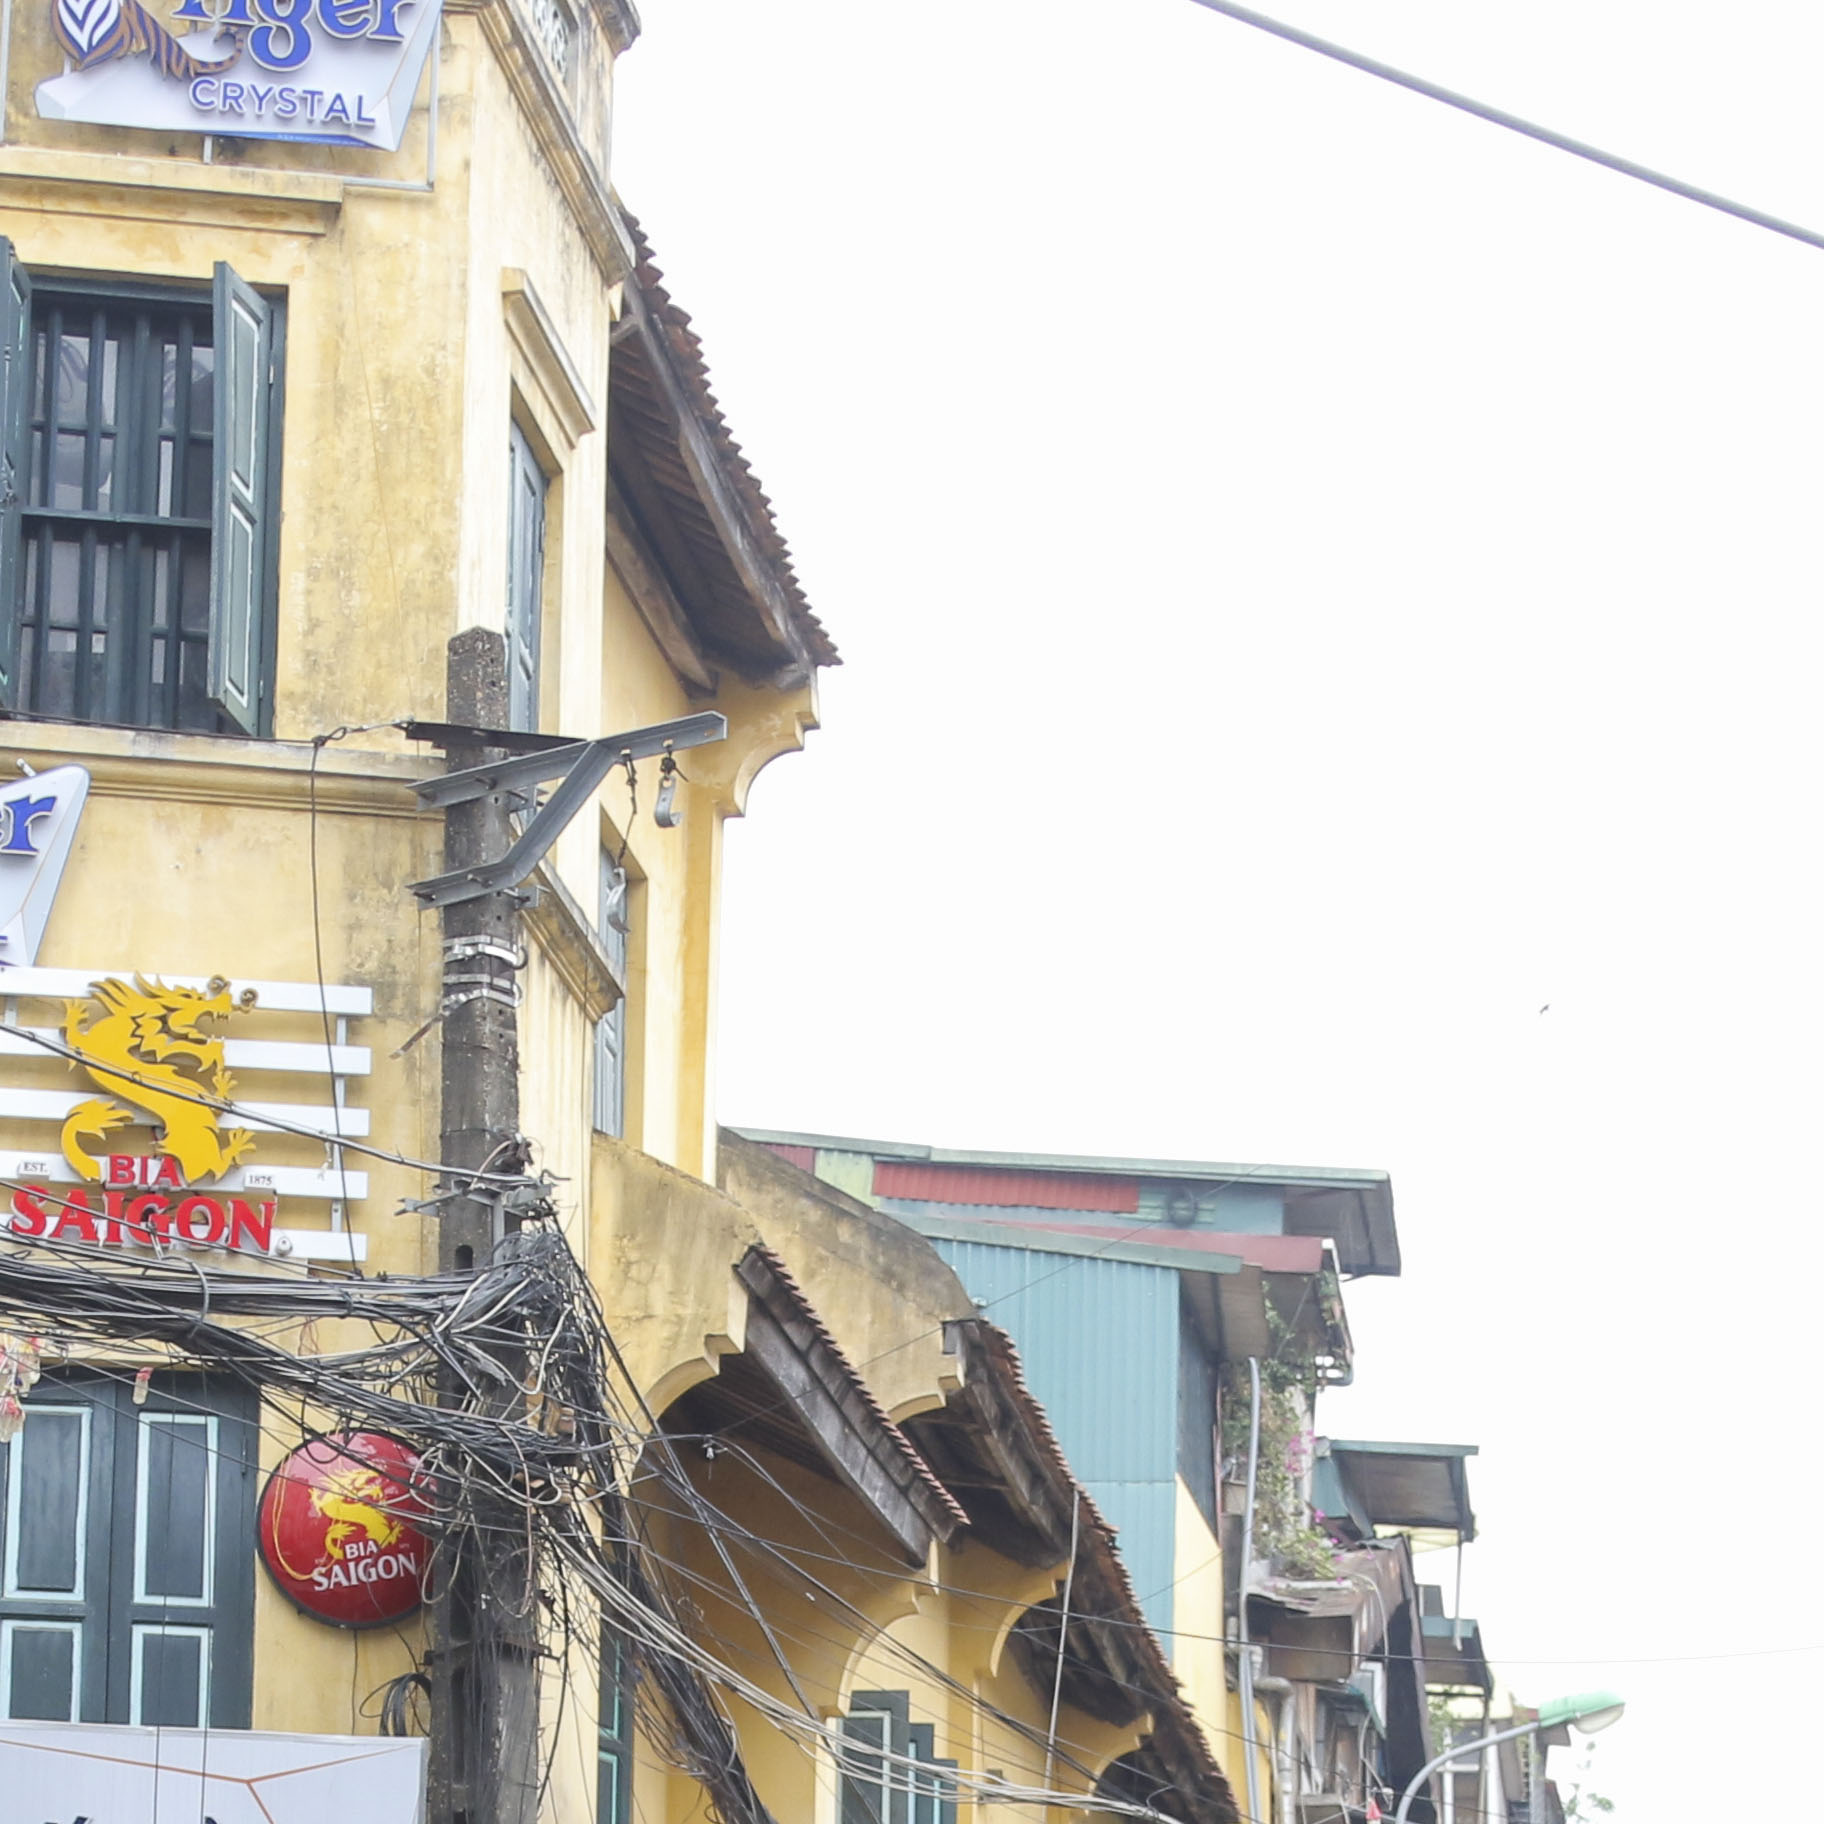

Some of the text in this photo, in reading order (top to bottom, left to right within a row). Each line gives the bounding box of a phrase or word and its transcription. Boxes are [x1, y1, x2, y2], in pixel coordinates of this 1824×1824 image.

[190, 77, 376, 128] CRYSTAL
[23, 1162, 48, 1174] EST.
[108, 1154, 273, 1187] BIA 1875
[11, 1184, 276, 1250] SAIGON
[344, 1541, 378, 1561] BIA
[312, 1552, 417, 1591] SAIGON
